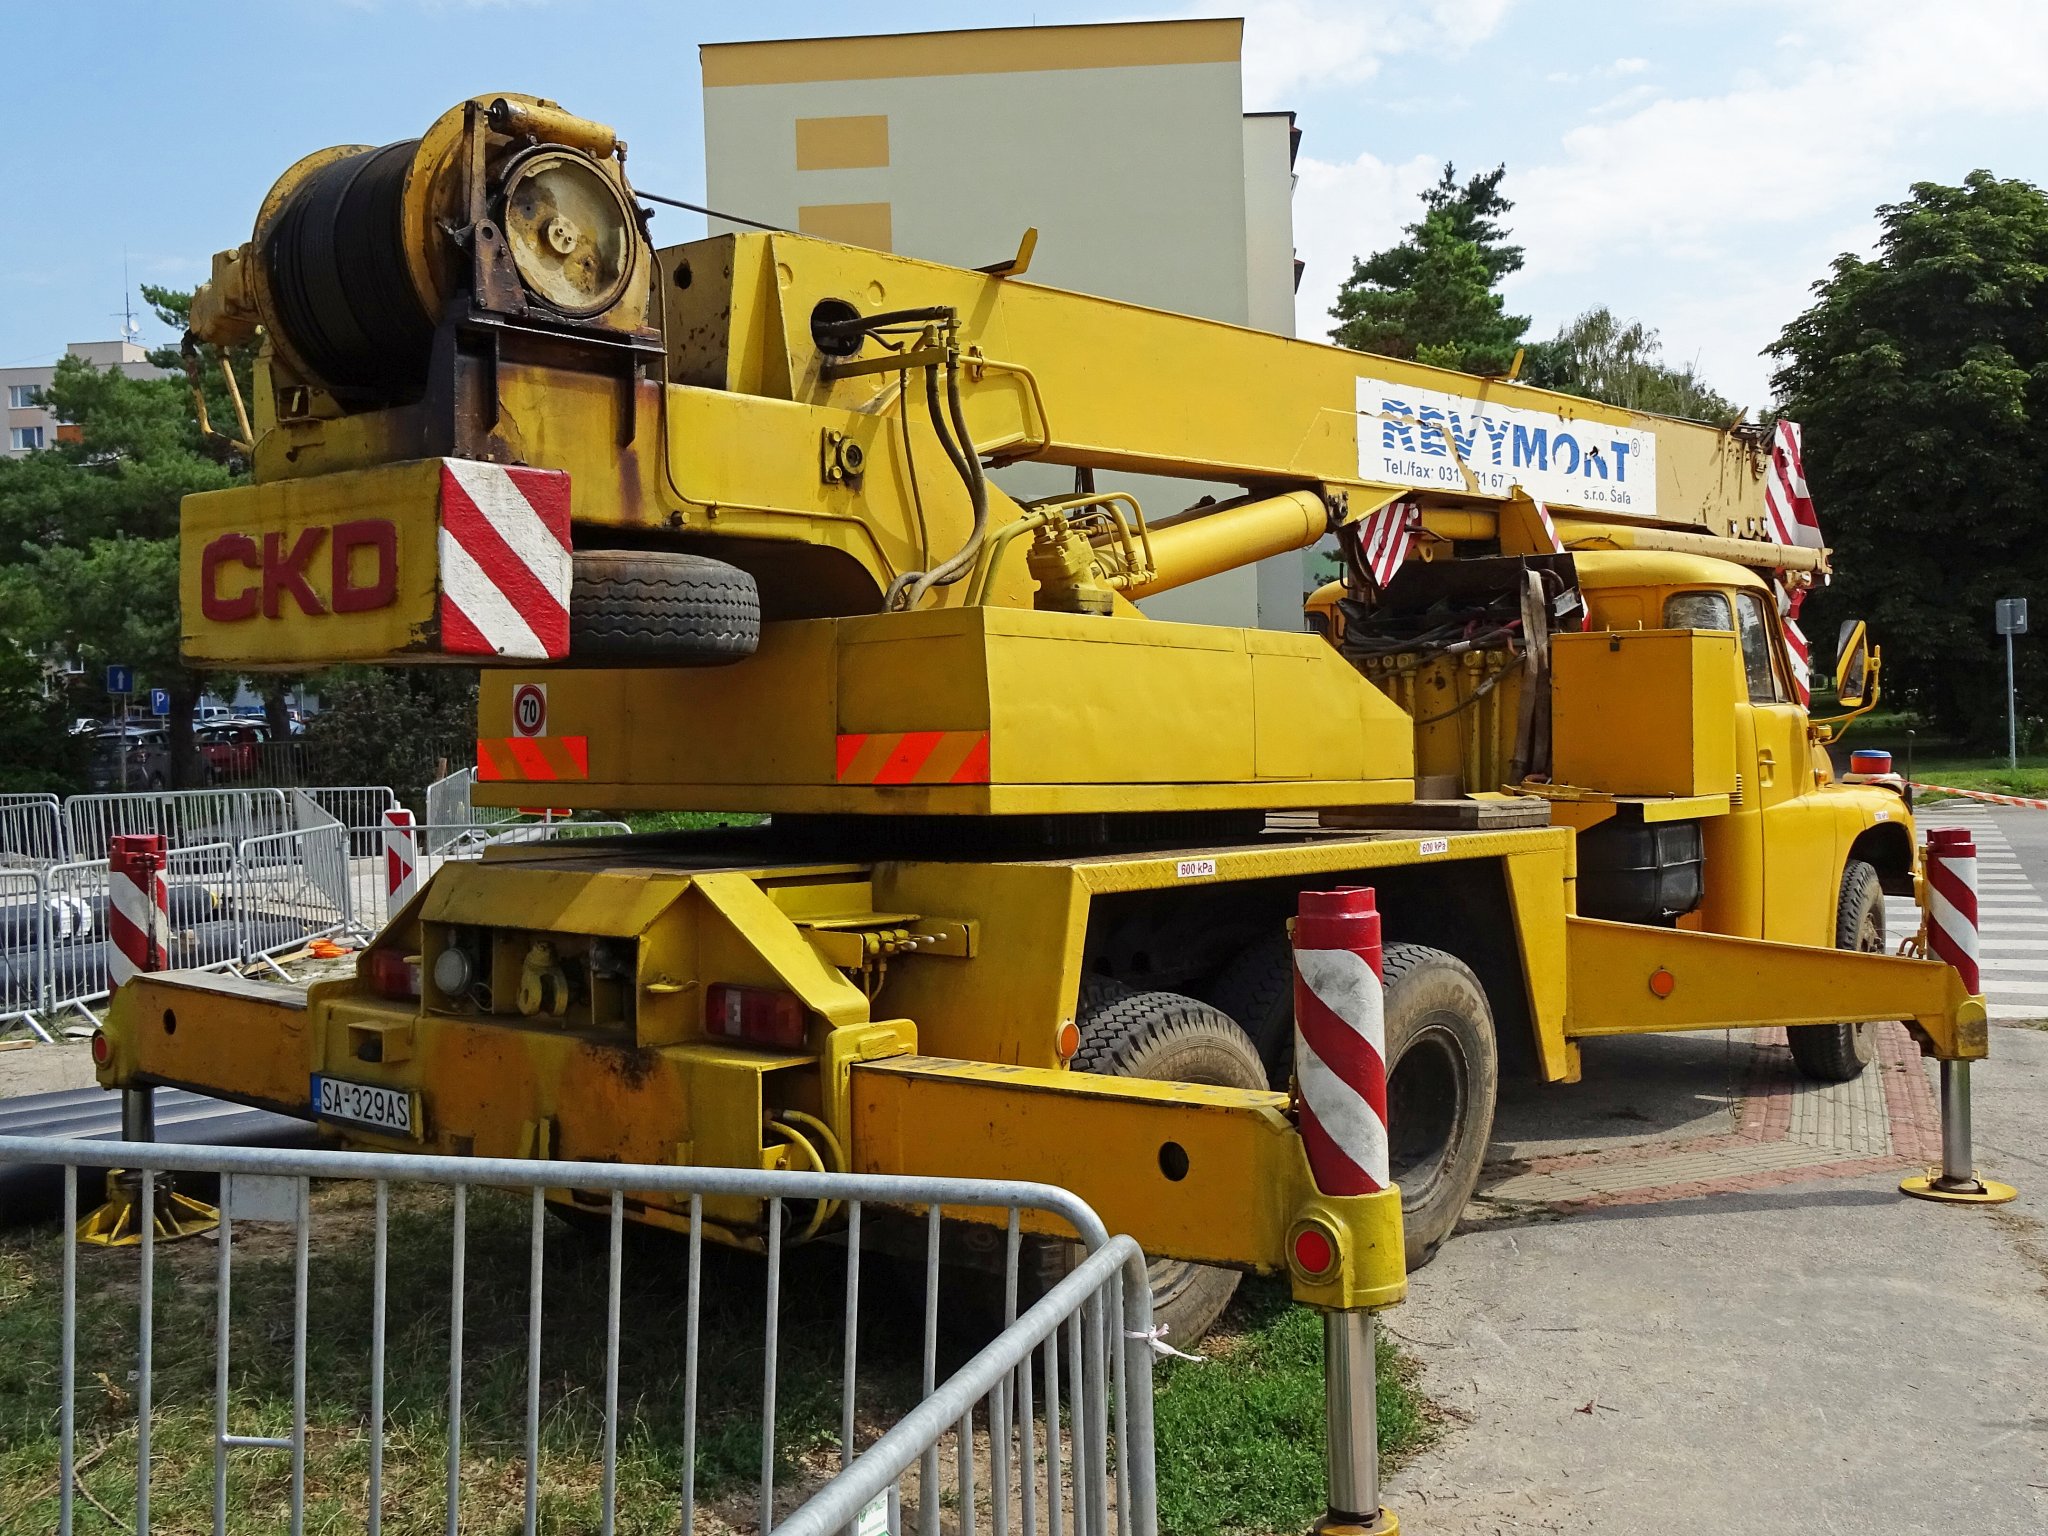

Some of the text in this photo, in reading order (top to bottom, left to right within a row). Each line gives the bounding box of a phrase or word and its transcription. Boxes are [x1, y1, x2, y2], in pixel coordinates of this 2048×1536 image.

[1491, 473, 1504, 489] 67
[1584, 489, 1608, 501] s.r.o.
[201, 518, 398, 623] CKD
[156, 692, 165, 707] P
[522, 699, 537, 723] 70
[1421, 841, 1434, 853] 600
[1181, 862, 1213, 875] 600 kPa
[322, 1081, 408, 1127] SA-329AS
